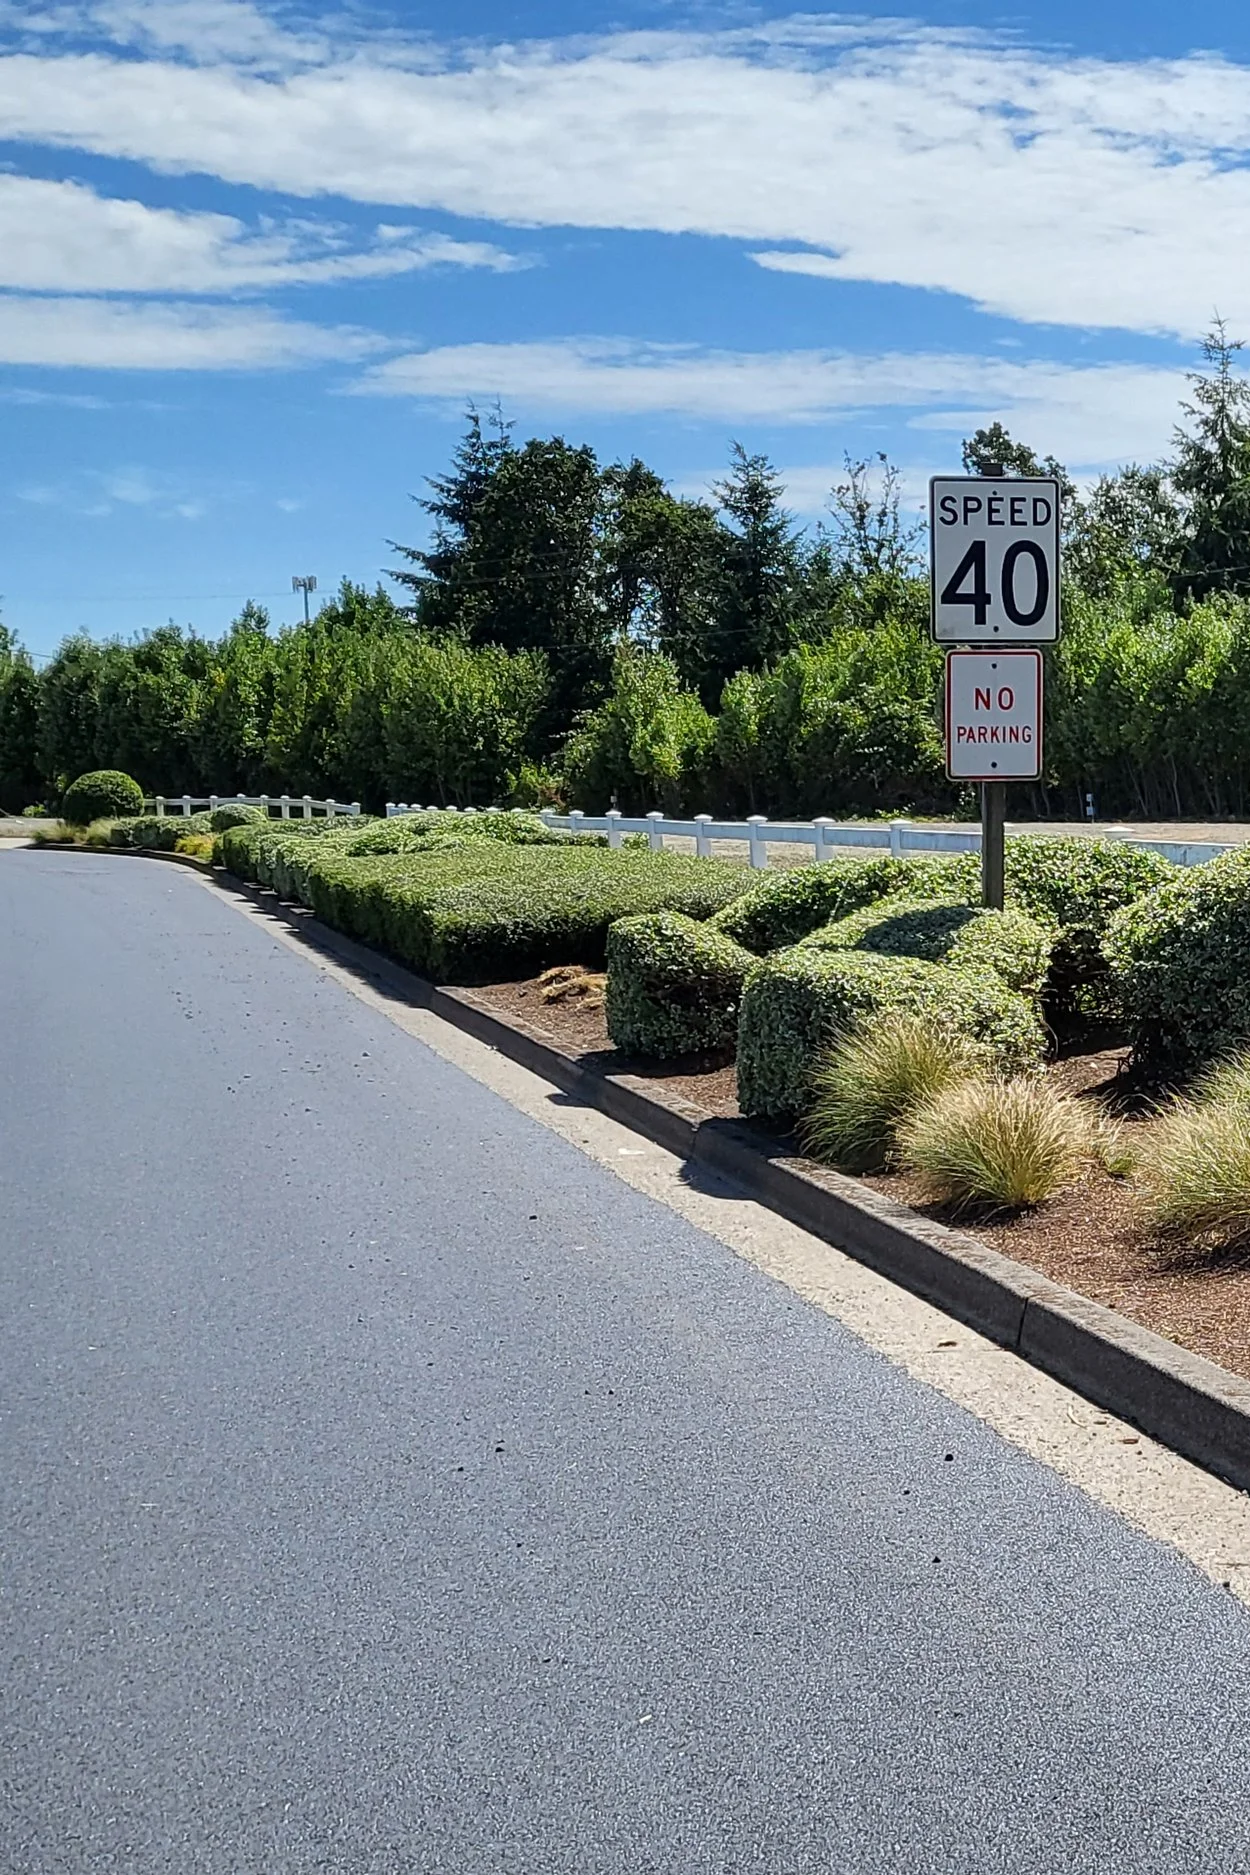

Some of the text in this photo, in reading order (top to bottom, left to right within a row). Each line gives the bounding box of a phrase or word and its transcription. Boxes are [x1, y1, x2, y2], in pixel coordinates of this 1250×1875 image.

[939, 496, 1051, 526] SPEED
[940, 539, 1049, 626] 40
[974, 687, 1014, 710] NO
[956, 726, 1032, 743] PARKING
